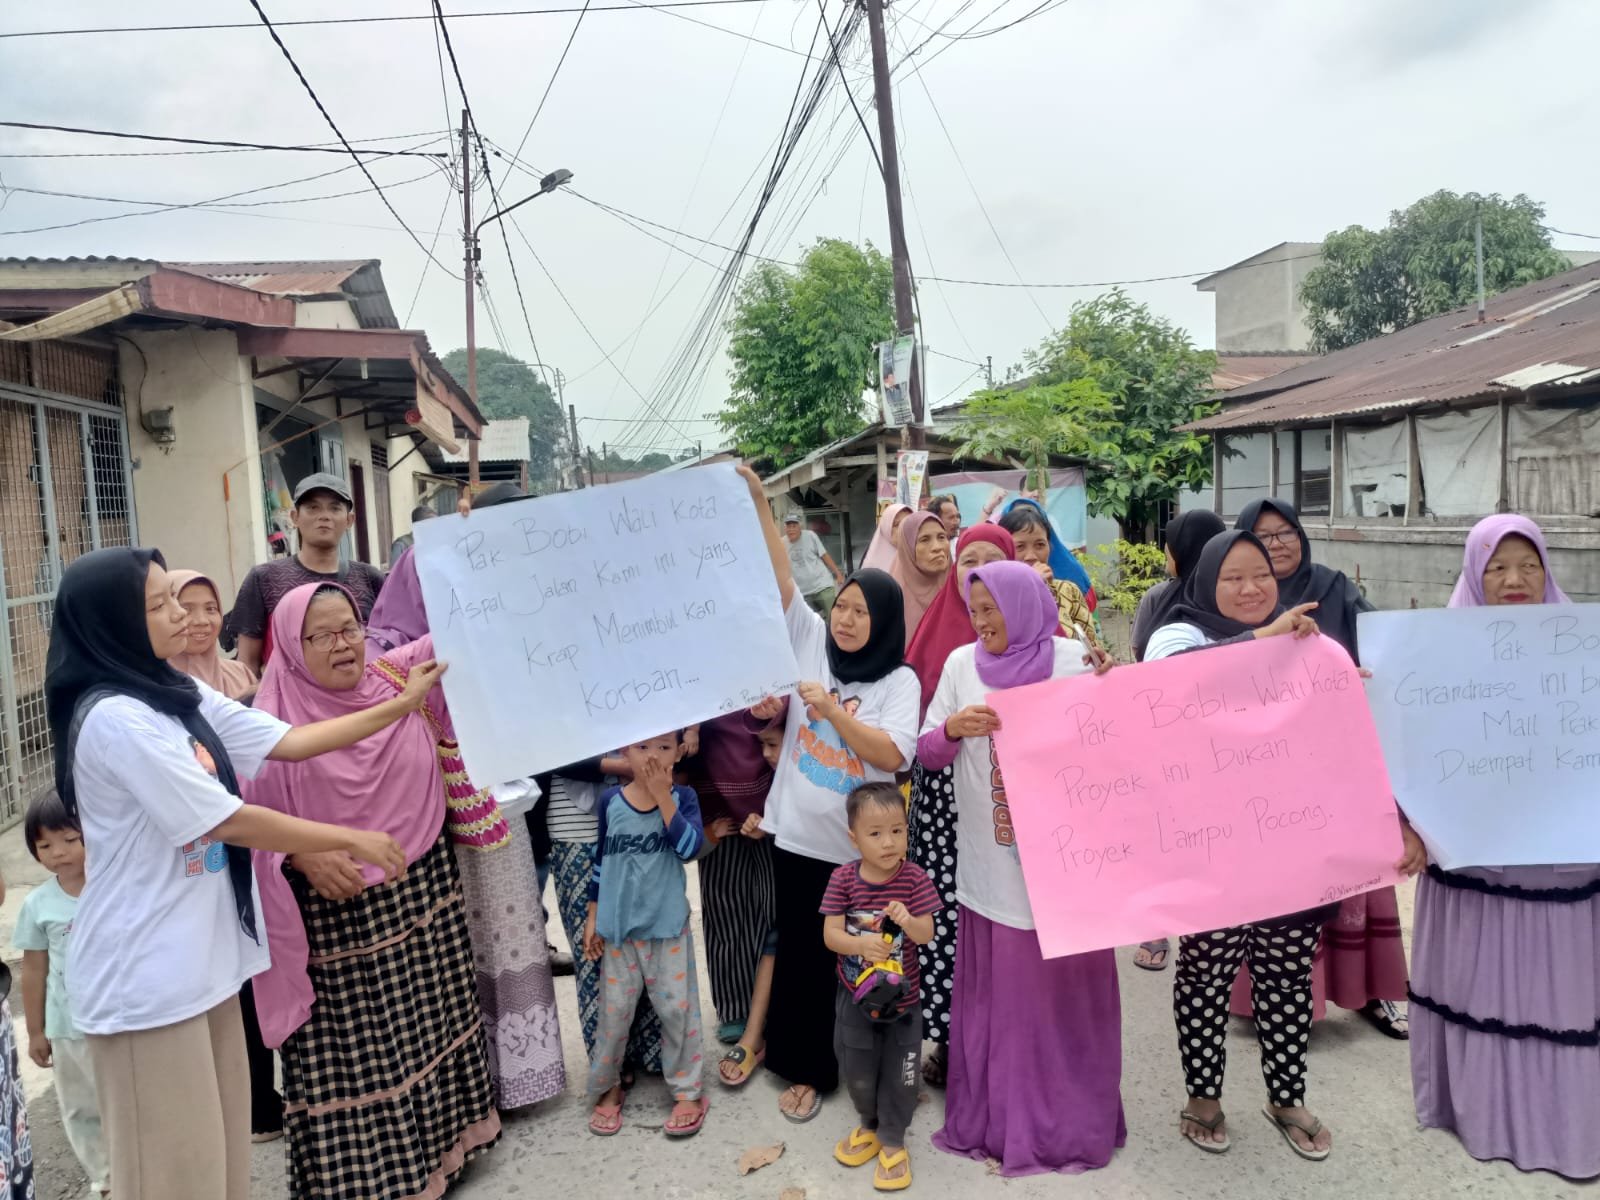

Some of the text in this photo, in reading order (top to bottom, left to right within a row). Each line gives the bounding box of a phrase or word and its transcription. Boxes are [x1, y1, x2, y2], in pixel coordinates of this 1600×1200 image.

[456, 530, 505, 571] Pak
[447, 587, 506, 630] Aspal
[512, 574, 577, 616] Jalan
[1486, 620, 1528, 661] Pak
[1065, 702, 1120, 746] Pak
[1483, 709, 1539, 741] Mall
[1054, 765, 1146, 812] Proyek
[1051, 824, 1134, 879] Proyek
